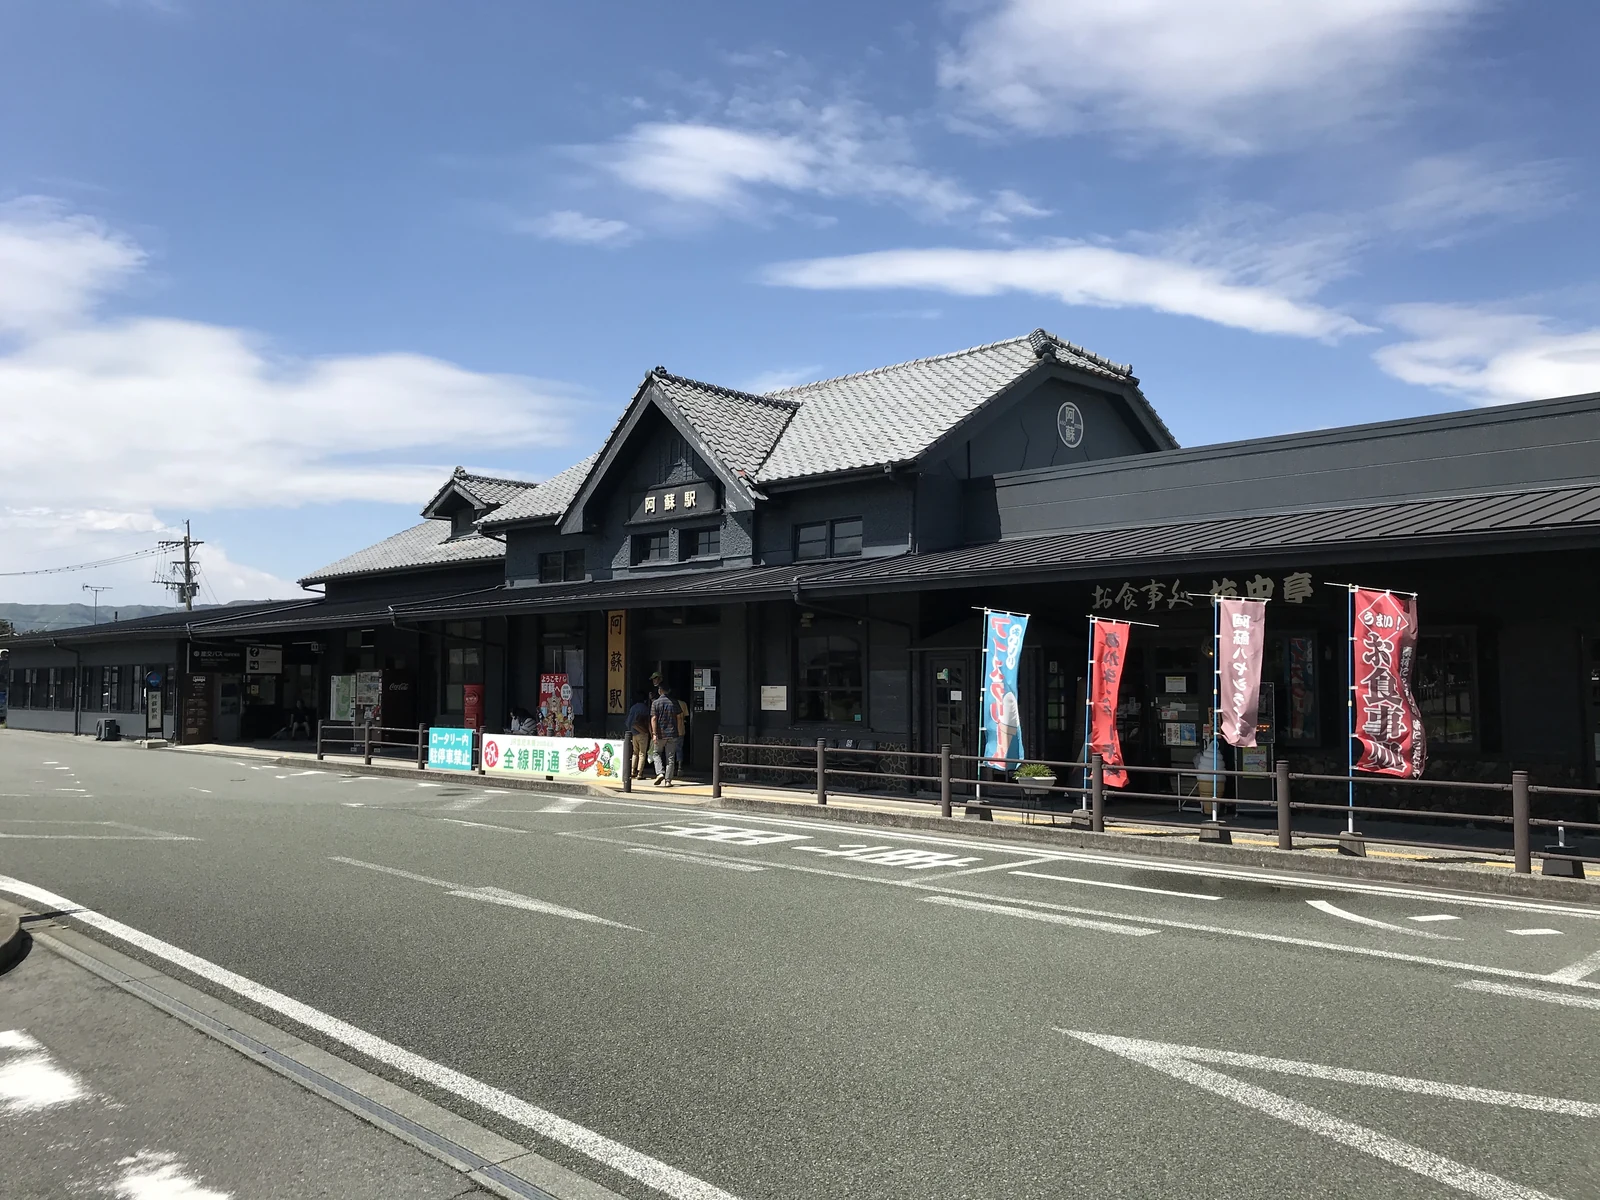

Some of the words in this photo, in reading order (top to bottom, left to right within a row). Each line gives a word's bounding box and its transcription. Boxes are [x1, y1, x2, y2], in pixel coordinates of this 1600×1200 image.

[644, 490, 697, 514] 阿蘇駅
[1091, 578, 1194, 612] お食事処
[608, 614, 624, 709] 阿蘇駅
[1360, 632, 1408, 773] お食事処
[432, 733, 469, 747] ロータリー内
[429, 747, 470, 766] 駐停車禁止
[485, 743, 498, 765] 祝
[503, 747, 560, 773] 全線開通
